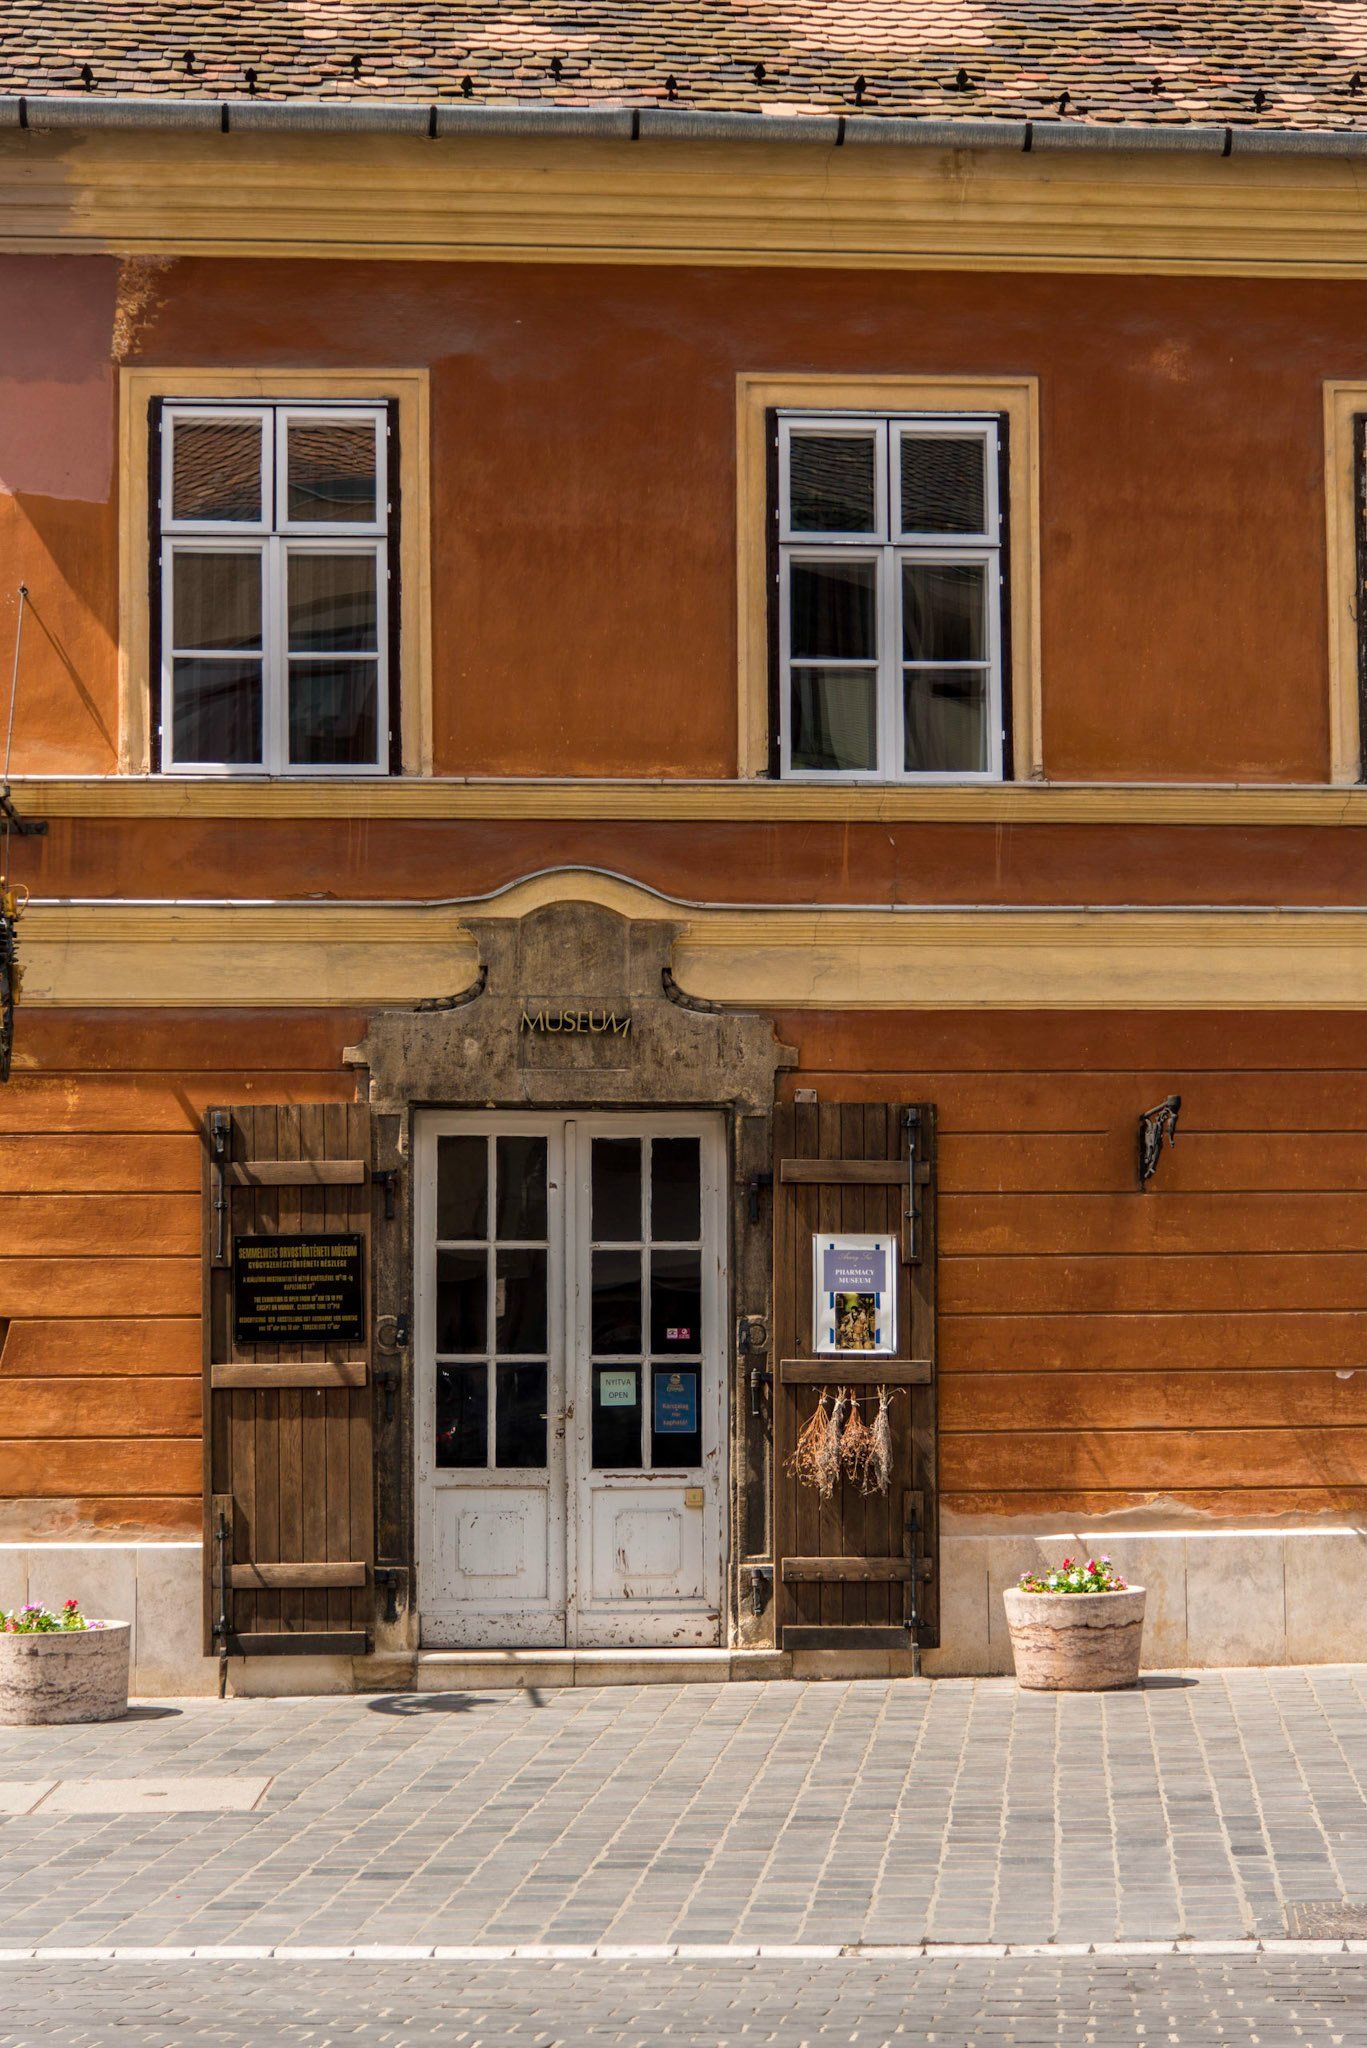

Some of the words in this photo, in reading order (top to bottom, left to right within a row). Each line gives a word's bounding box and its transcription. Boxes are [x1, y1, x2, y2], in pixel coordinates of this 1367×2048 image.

[520, 1010, 631, 1038] MUSEUM
[238, 1247, 278, 1259] SEMMELWEIS
[331, 1243, 358, 1257] MÚZEUM
[605, 1378, 632, 1386] NYITVA
[608, 1391, 629, 1399] OPEN
